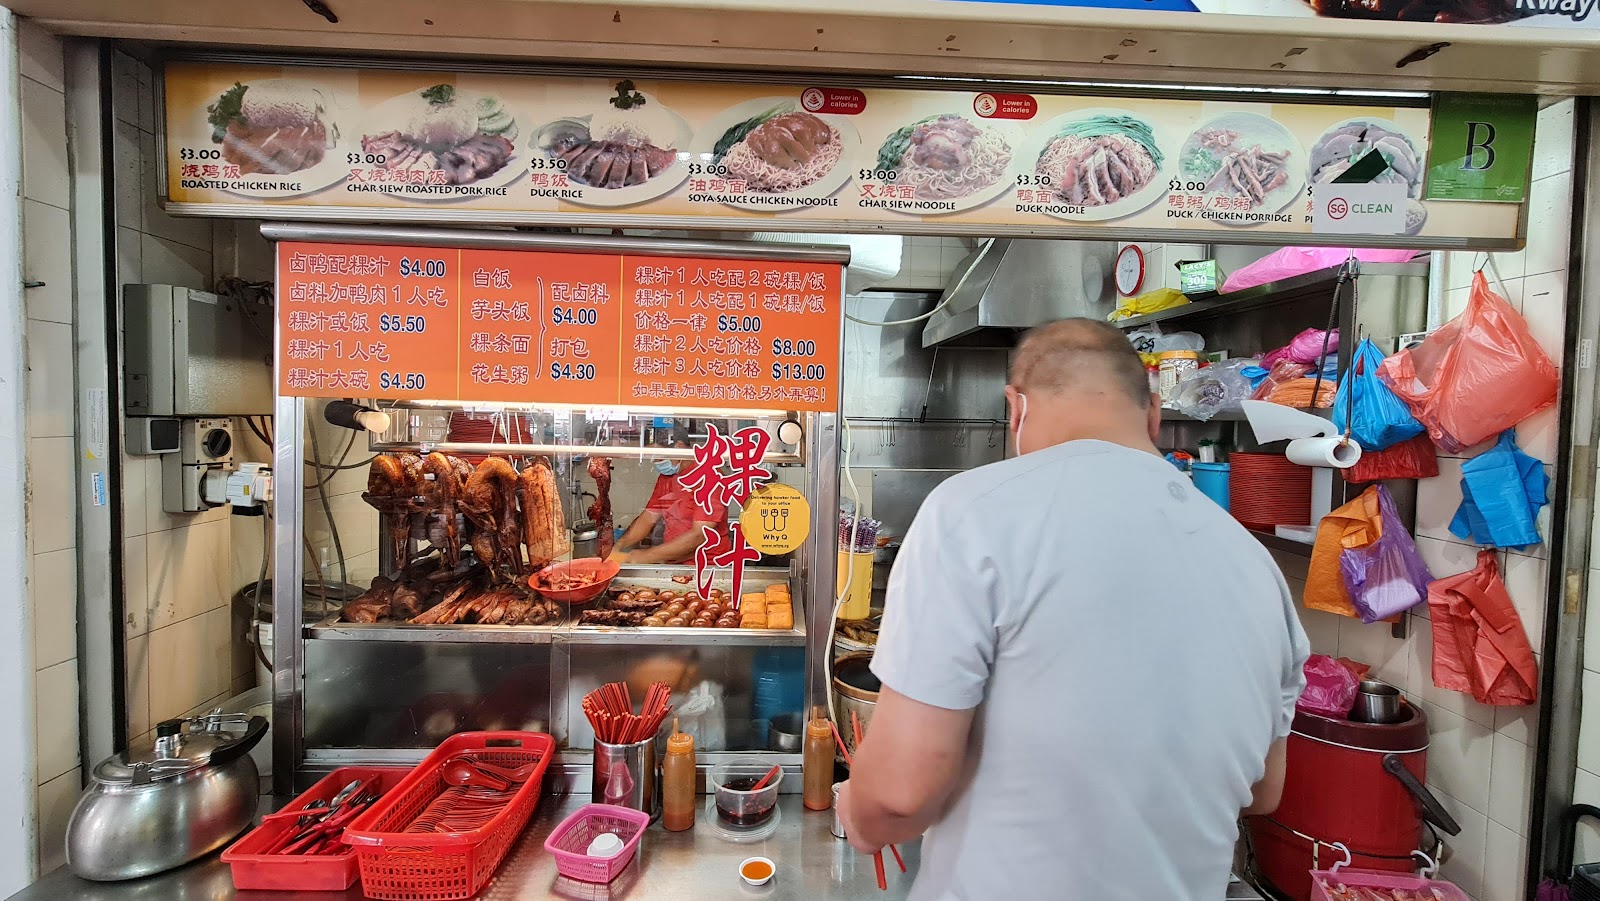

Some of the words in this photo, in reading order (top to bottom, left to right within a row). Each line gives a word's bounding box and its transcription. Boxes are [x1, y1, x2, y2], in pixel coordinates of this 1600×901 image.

[1459, 121, 1496, 170] B
[180, 148, 221, 160] $3.00
[347, 152, 386, 164] $3.00
[181, 164, 241, 179] 烧鸡饭
[531, 158, 567, 170] $3.50
[688, 163, 727, 175] $3.00
[348, 169, 447, 184] 叉烧烧肉饭
[531, 173, 569, 188] 鸭饭
[859, 168, 898, 180] $3.00
[1016, 174, 1051, 186] $3.50
[181, 180, 229, 189] ROASTED
[231, 181, 277, 190] CHICKEN
[279, 182, 302, 191] RICE
[347, 184, 377, 192] CHAR
[379, 184, 404, 193] SIEW
[405, 185, 450, 194] ROASTED
[454, 186, 483, 195] PORK
[485, 187, 507, 196] RICE
[689, 179, 747, 194] 油鸡面
[860, 184, 916, 199] 叉烧面
[1168, 180, 1205, 191] $2.00
[530, 189, 559, 198] DUCK
[561, 190, 583, 198] RICE
[688, 194, 714, 203] SOYA
[716, 195, 748, 204] SAUCE
[749, 196, 795, 205] CHICKEN
[797, 197, 838, 206] NOODLE
[1017, 189, 1053, 204] 鸭面
[858, 199, 888, 208] CHAR
[890, 200, 913, 208] SIEW
[914, 201, 956, 210] NOODLE
[1015, 204, 1043, 213] DUCK
[1045, 205, 1086, 214] NOODLE
[1330, 203, 1346, 214] SG
[1351, 203, 1393, 214] CLEAN
[1167, 210, 1194, 219] DUCK
[1201, 211, 1243, 220] CHICKEN
[1245, 213, 1292, 222] PORRIDGE
[289, 252, 390, 276] 卤鸭配粿汁
[400, 257, 445, 277] $4.00
[473, 268, 512, 289] 白饭
[1187, 275, 1207, 285] 300
[551, 283, 610, 304] 配卤料
[471, 299, 531, 322] 芋头饭
[552, 306, 597, 325] $4.00
[288, 311, 370, 332] 粿汁或饭
[379, 313, 425, 333] $5.50
[634, 311, 707, 331] 价格一律
[717, 314, 761, 333] $5.00
[471, 333, 531, 354] 粿条面
[550, 338, 589, 358] 打包
[772, 338, 815, 357] $8.00
[471, 364, 528, 385] 花生粥
[551, 361, 595, 380] $4.30
[772, 362, 825, 380] $13.00
[287, 369, 370, 390] 粿汁大碗
[380, 370, 425, 391] $4.50
